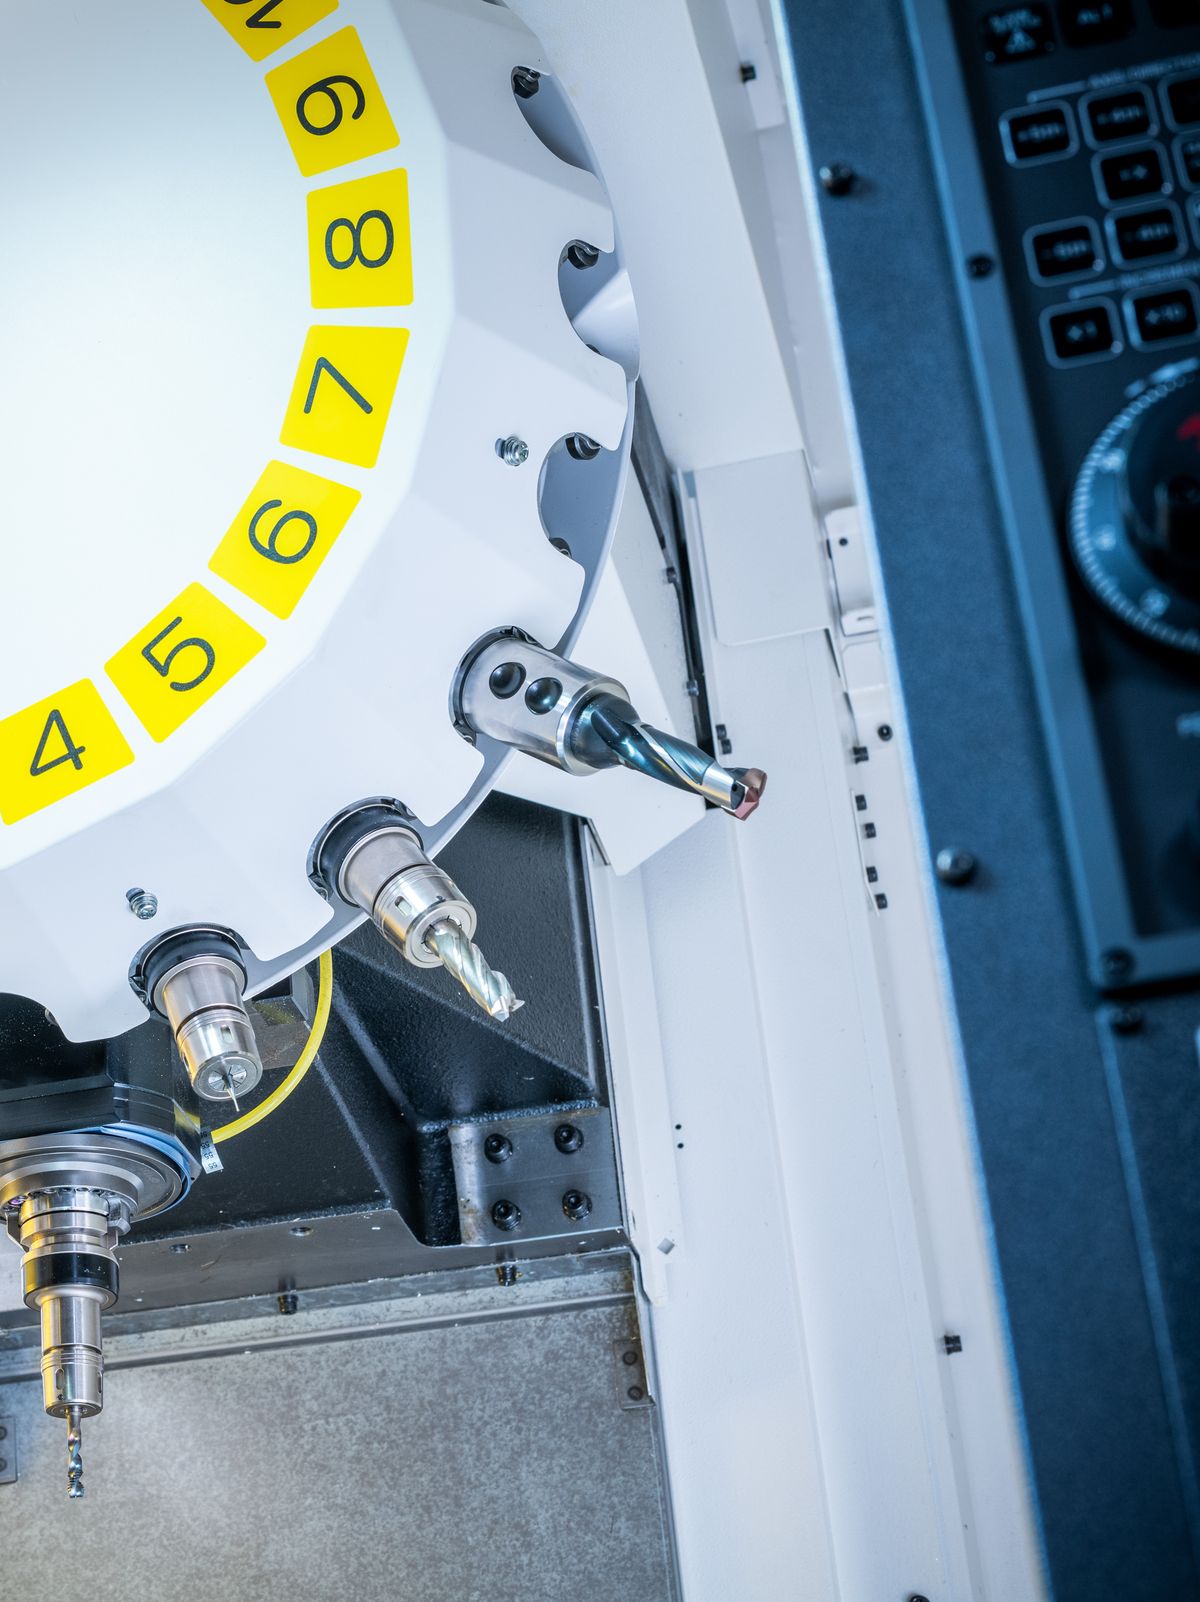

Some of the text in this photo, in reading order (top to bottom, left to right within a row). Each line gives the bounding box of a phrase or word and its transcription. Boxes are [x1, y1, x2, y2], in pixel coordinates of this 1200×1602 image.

[296, 75, 366, 136] 9
[325, 210, 395, 270] 8
[304, 358, 374, 415] 7
[249, 501, 319, 566] 6
[142, 617, 216, 693] 5
[30, 710, 87, 778] 4
